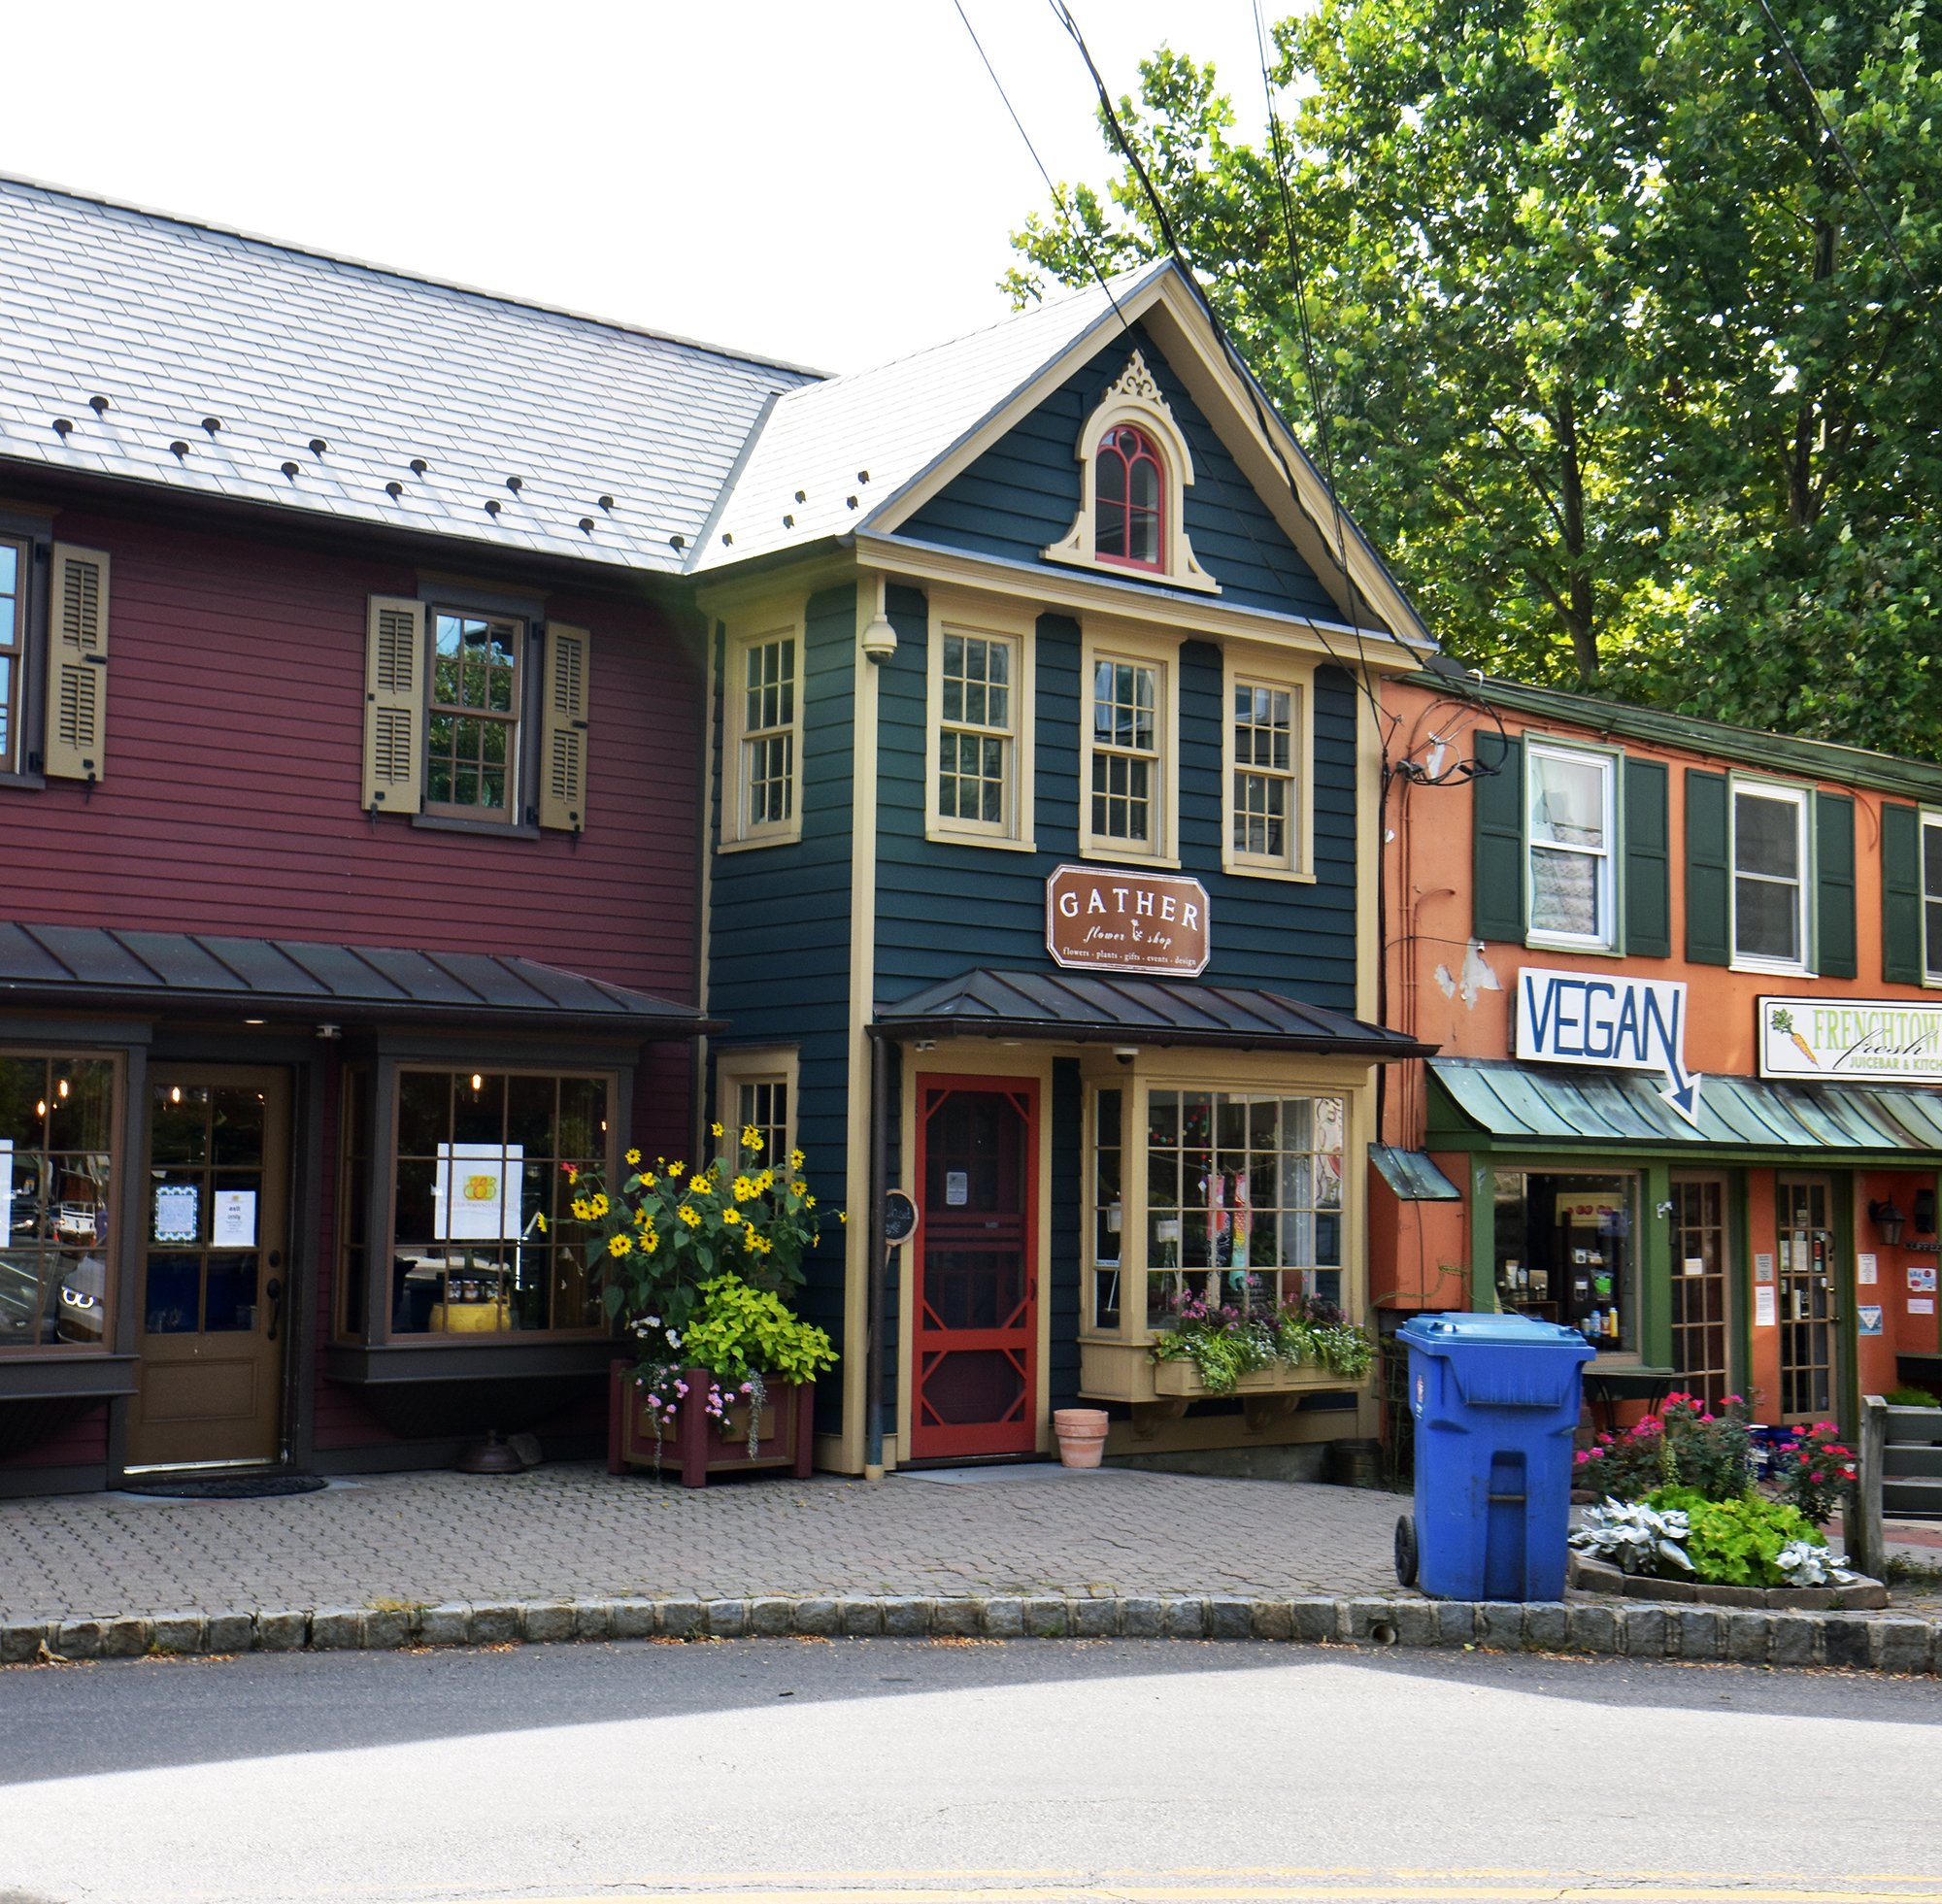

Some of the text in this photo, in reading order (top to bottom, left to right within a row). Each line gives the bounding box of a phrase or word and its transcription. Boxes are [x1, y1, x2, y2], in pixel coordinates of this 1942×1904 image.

[1058, 887, 1198, 932] GATHER
[1083, 925, 1126, 944] flower
[1147, 931, 1172, 950] shop
[1062, 947, 1196, 966] flowers plants gifts events design
[1525, 975, 1681, 1062] VEGAN
[1832, 1027, 1939, 1070] fresh
[1849, 1056, 1900, 1070] JUICEBAR
